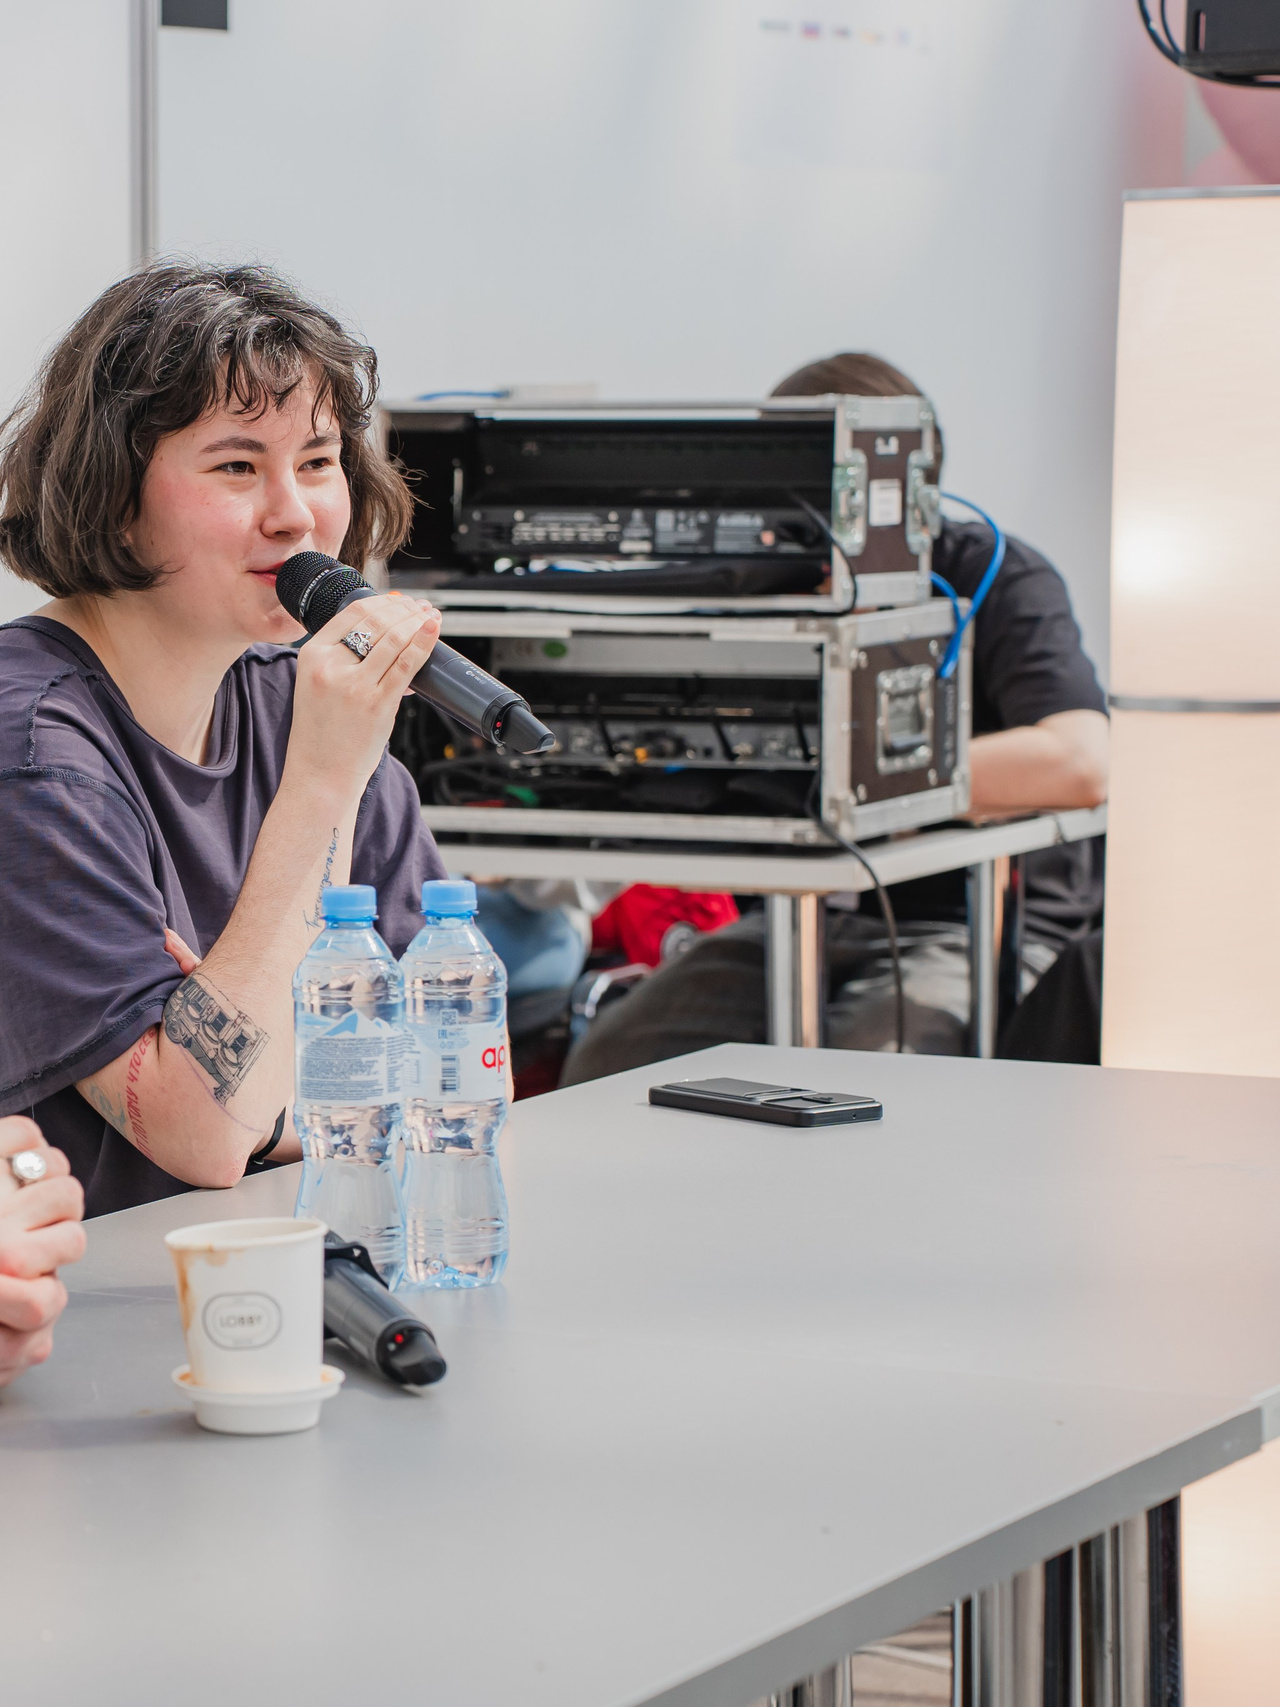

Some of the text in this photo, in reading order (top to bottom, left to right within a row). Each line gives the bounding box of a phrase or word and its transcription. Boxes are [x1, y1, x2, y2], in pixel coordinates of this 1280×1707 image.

[138, 1026, 158, 1056] СЕБ
[127, 1052, 141, 1083] ЧТО
[126, 1085, 149, 1144] ПОТОМУ
[219, 1314, 263, 1329] LOBBY
